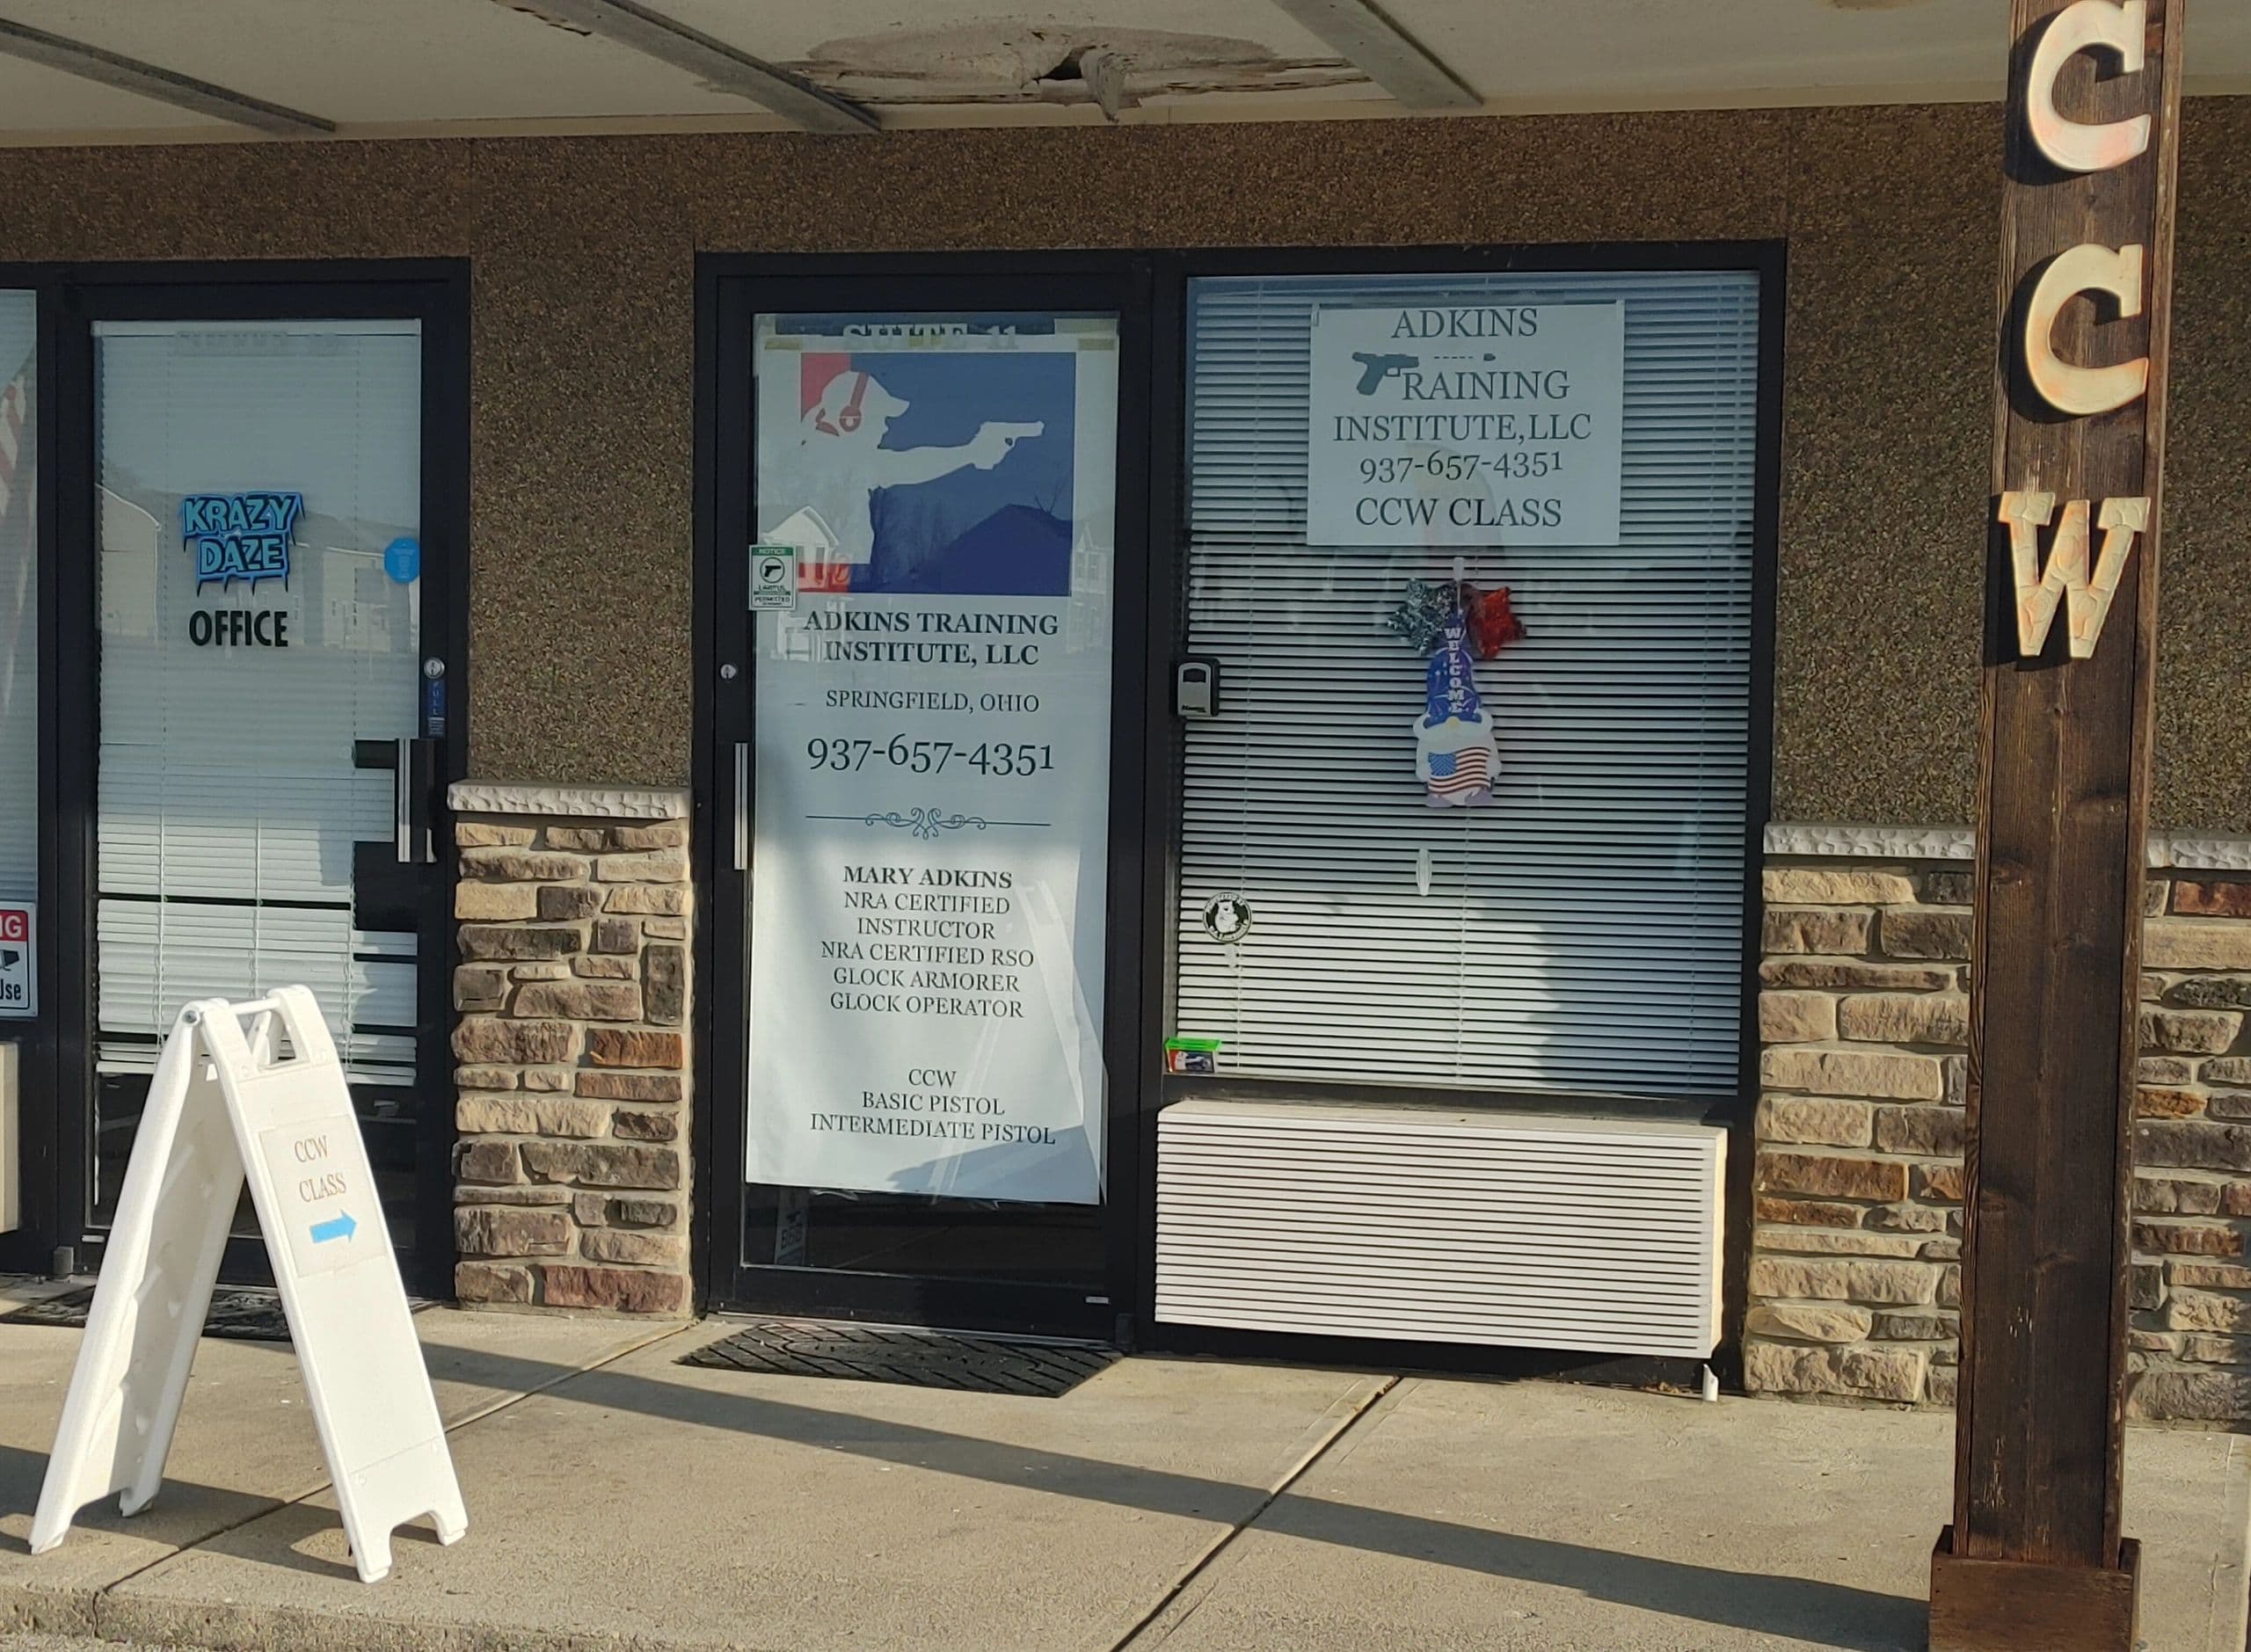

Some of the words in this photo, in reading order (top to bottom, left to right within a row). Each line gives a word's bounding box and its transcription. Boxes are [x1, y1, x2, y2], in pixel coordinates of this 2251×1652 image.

[1391, 307, 1538, 338] ADKINS
[1998, 0, 2151, 659] CCW
[1359, 449, 1563, 484] 937-657-4351
[183, 494, 296, 535] KRAZY
[1355, 498, 1439, 527] CCW
[1449, 498, 1562, 528] CLASS
[199, 535, 287, 576] DAZE
[188, 609, 289, 648] OFFICE
[803, 610, 910, 633] ADKINS
[917, 612, 1059, 636] TRAINING
[823, 641, 978, 668] INSTITUTE,
[985, 644, 1039, 666] LLC
[1444, 627, 1467, 715] WELCOME
[826, 689, 974, 714] SPRINGFIELD,
[980, 693, 1039, 713] OHIO
[807, 732, 1055, 776] 937-657-4351
[842, 865, 915, 885] MARY
[919, 869, 1012, 890] ADKINS
[843, 891, 888, 910] NRA
[894, 893, 1010, 915] CERTIFIED
[857, 917, 995, 940] INSTRUCTOR
[821, 941, 863, 960] NRA
[869, 942, 985, 965] CERTIFIED
[991, 949, 1034, 968] RSO
[834, 967, 905, 987] GLOCK
[910, 971, 1021, 993] ARMORER
[830, 992, 901, 1013] GLOCK
[906, 996, 1024, 1018] OPERATOR
[908, 1068, 957, 1088] CCW
[862, 1091, 923, 1111] BASIC
[929, 1095, 1005, 1116] PISTOL
[810, 1113, 975, 1140] INTERMEDIATE
[980, 1123, 1056, 1145] PISTOL
[294, 1135, 329, 1163] CCW
[299, 1172, 346, 1204] CLASS
